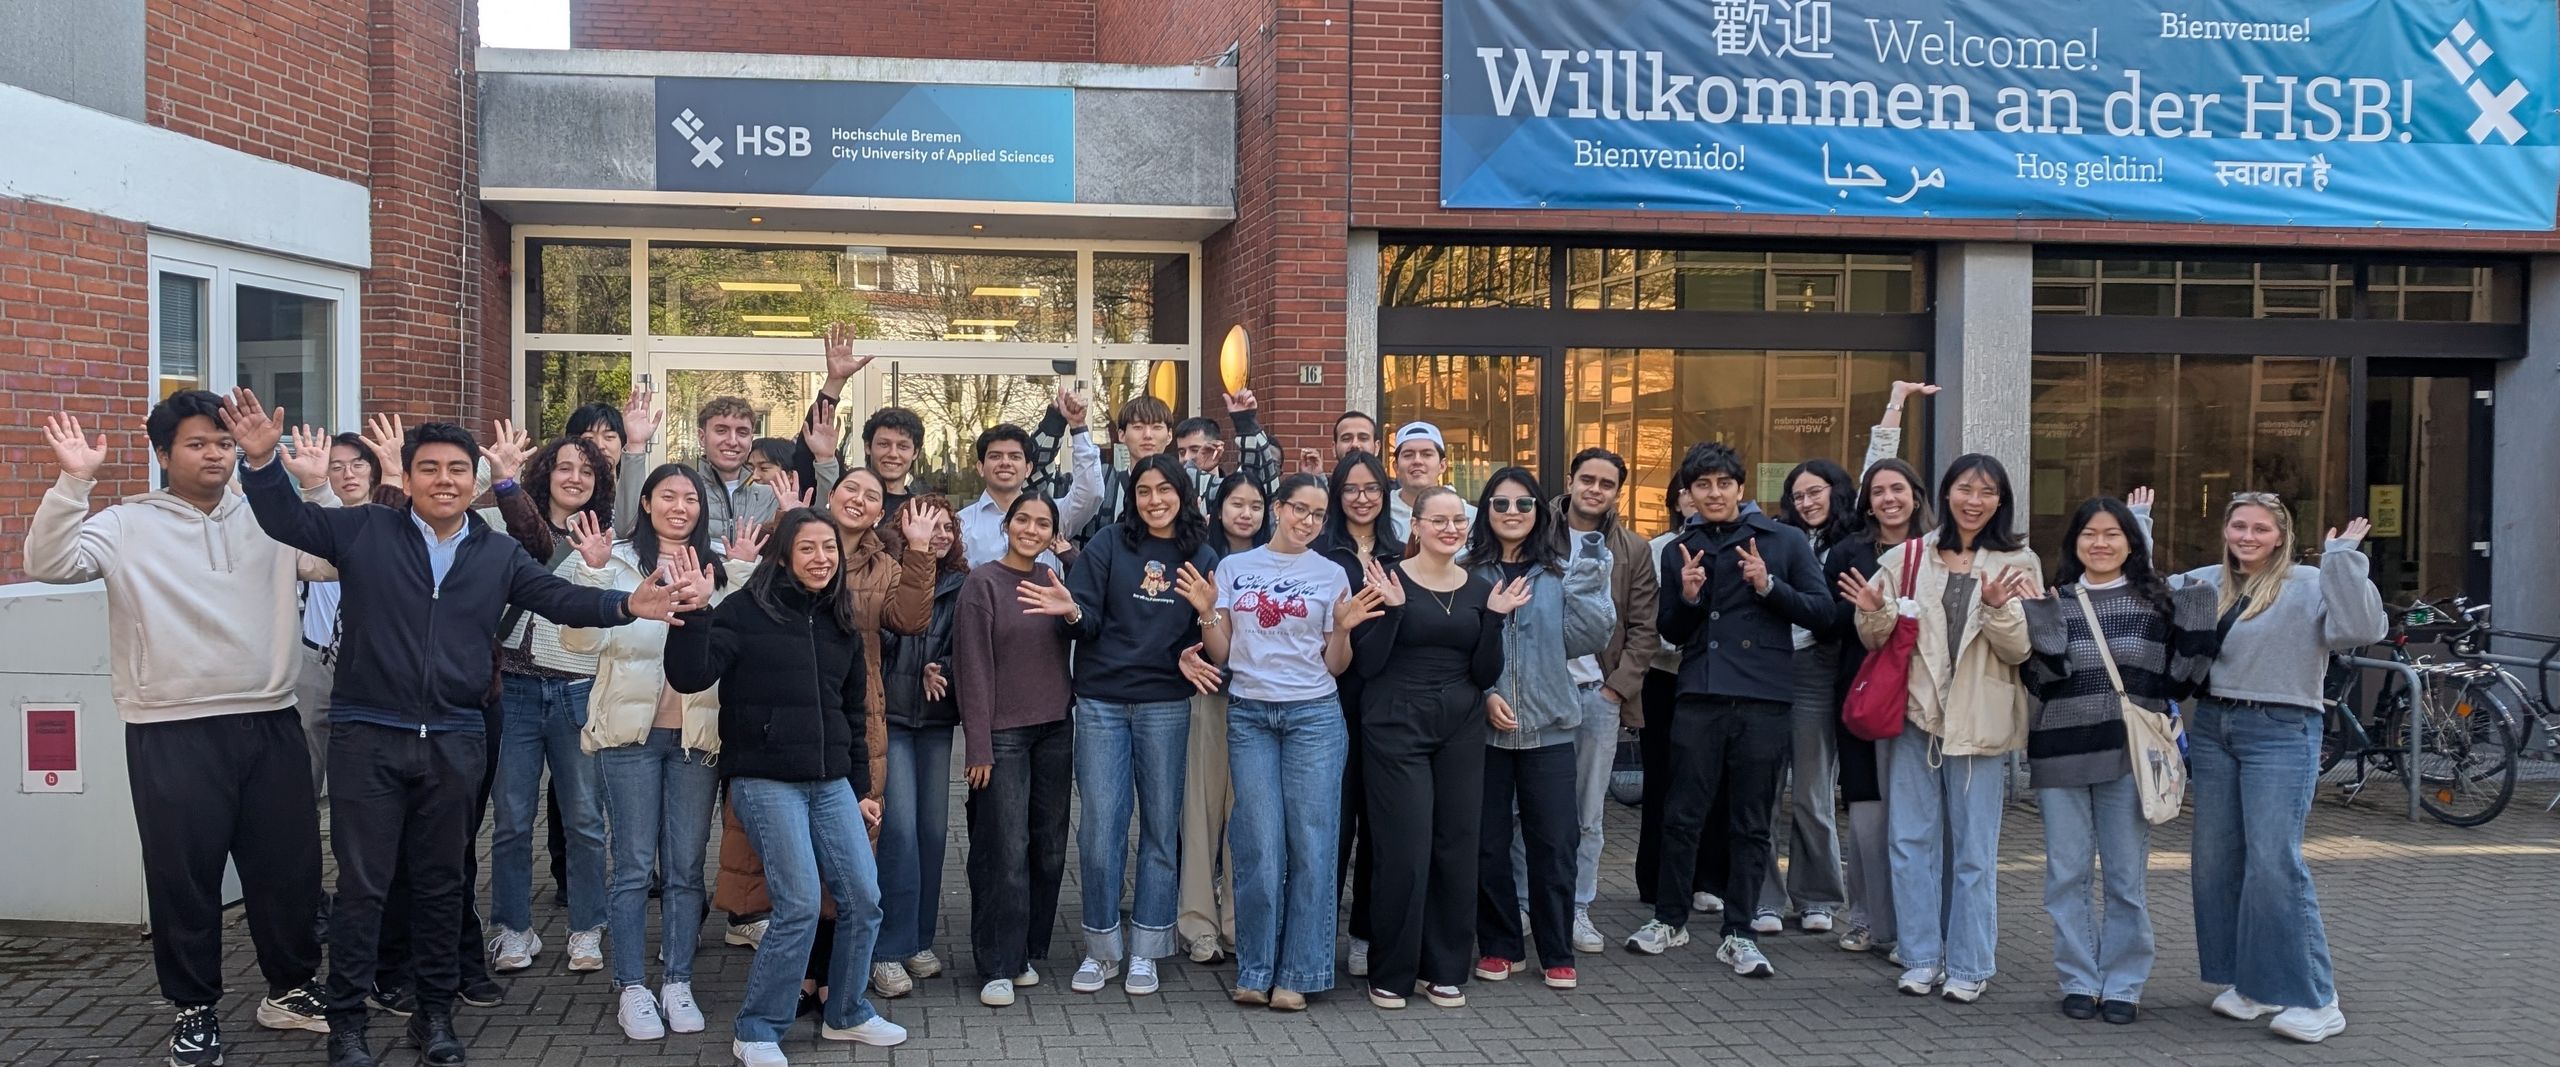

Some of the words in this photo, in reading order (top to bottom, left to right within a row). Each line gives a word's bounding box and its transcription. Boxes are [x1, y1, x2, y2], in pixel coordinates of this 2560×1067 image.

[1712, 0, 1834, 59] 歡迎
[2160, 12, 2311, 43] Bienvenue!
[1864, 18, 2098, 72] Welcome!
[1477, 47, 1975, 131] Willkommen
[1995, 85, 2083, 136] an
[2104, 69, 2220, 138] der
[2241, 75, 2413, 144] HSB!
[736, 124, 812, 157] HSB
[831, 128, 908, 142] Hochschule
[911, 130, 961, 143] Bremen
[831, 146, 858, 162] City
[861, 147, 928, 163] University
[931, 149, 944, 161] of
[947, 150, 996, 165] Applied
[999, 150, 1055, 164] Sciences
[1573, 139, 1745, 171] Bienvenido!
[2015, 153, 2068, 186] Hoş
[2075, 154, 2163, 188] geldin!
[2214, 161, 2307, 187] स्वागत
[2311, 152, 2332, 192] है
[1821, 141, 1946, 204] مرحبا
[1304, 366, 1318, 383] 16
